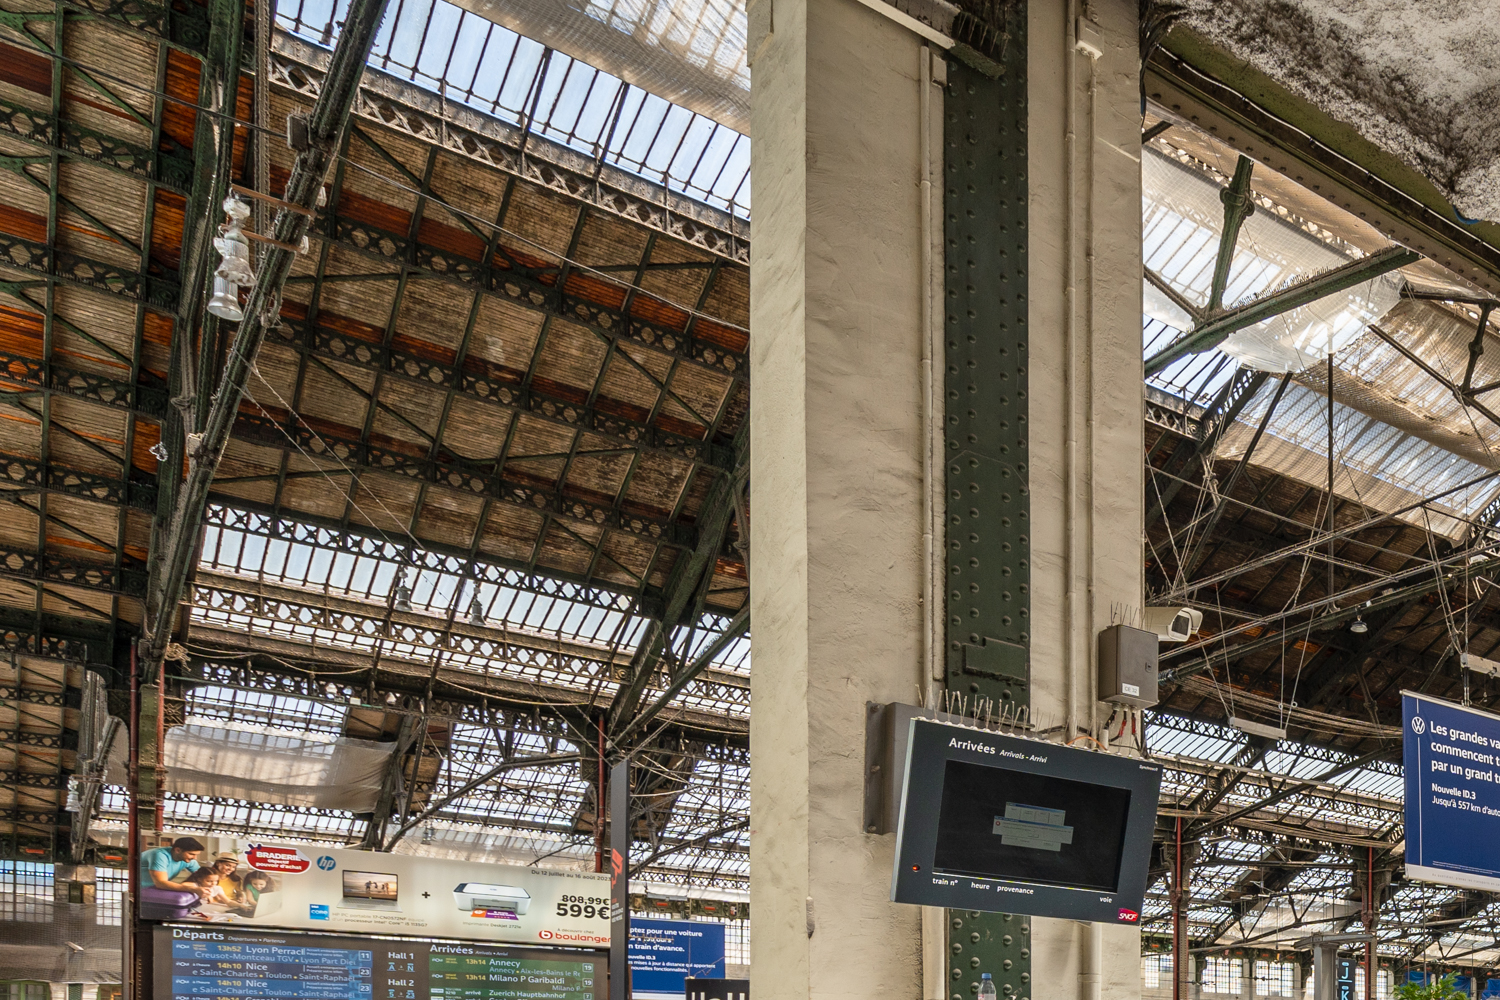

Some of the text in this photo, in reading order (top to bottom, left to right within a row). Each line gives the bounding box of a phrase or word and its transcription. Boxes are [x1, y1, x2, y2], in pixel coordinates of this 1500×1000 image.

[1430, 721, 1447, 736] Les
[1450, 727, 1488, 747] grandes
[949, 737, 1048, 763] Arrivées Arrivals Arrivi
[1430, 741, 1494, 767] commencent
[1431, 760, 1448, 773] par
[1450, 765, 1463, 775] un
[1465, 766, 1493, 782] grand
[1432, 783, 1476, 800] Nouvelle ID.3
[1432, 796, 1457, 809] Jusqu'à
[1458, 801, 1471, 811] 557
[1471, 803, 1481, 813] km
[932, 877, 948, 887] train
[971, 882, 990, 890] heure
[997, 885, 1034, 896] provenance
[562, 894, 610, 905] 808,99€
[556, 903, 610, 919] 599€
[1118, 912, 1138, 921] SNCF
[173, 929, 225, 940] Départs
[555, 932, 611, 943] boulanger
[246, 946, 269, 954] Lyon
[430, 945, 473, 954] Arrivées
[653, 944, 685, 952] d'avance.
[195, 951, 275, 961] Creusot-Montceau
[246, 963, 268, 971] Nice
[489, 959, 521, 968] Annecy
[200, 969, 258, 978] Saint-Charles
[521, 968, 564, 976] Aix-les-Bains
[1341, 967, 1349, 979] J
[489, 974, 518, 982] Milano
[528, 976, 565, 984] Garibaldi
[200, 987, 258, 995] Saint-Charles
[264, 988, 292, 996] Toulon
[517, 990, 566, 998] Hauptbahnhof
